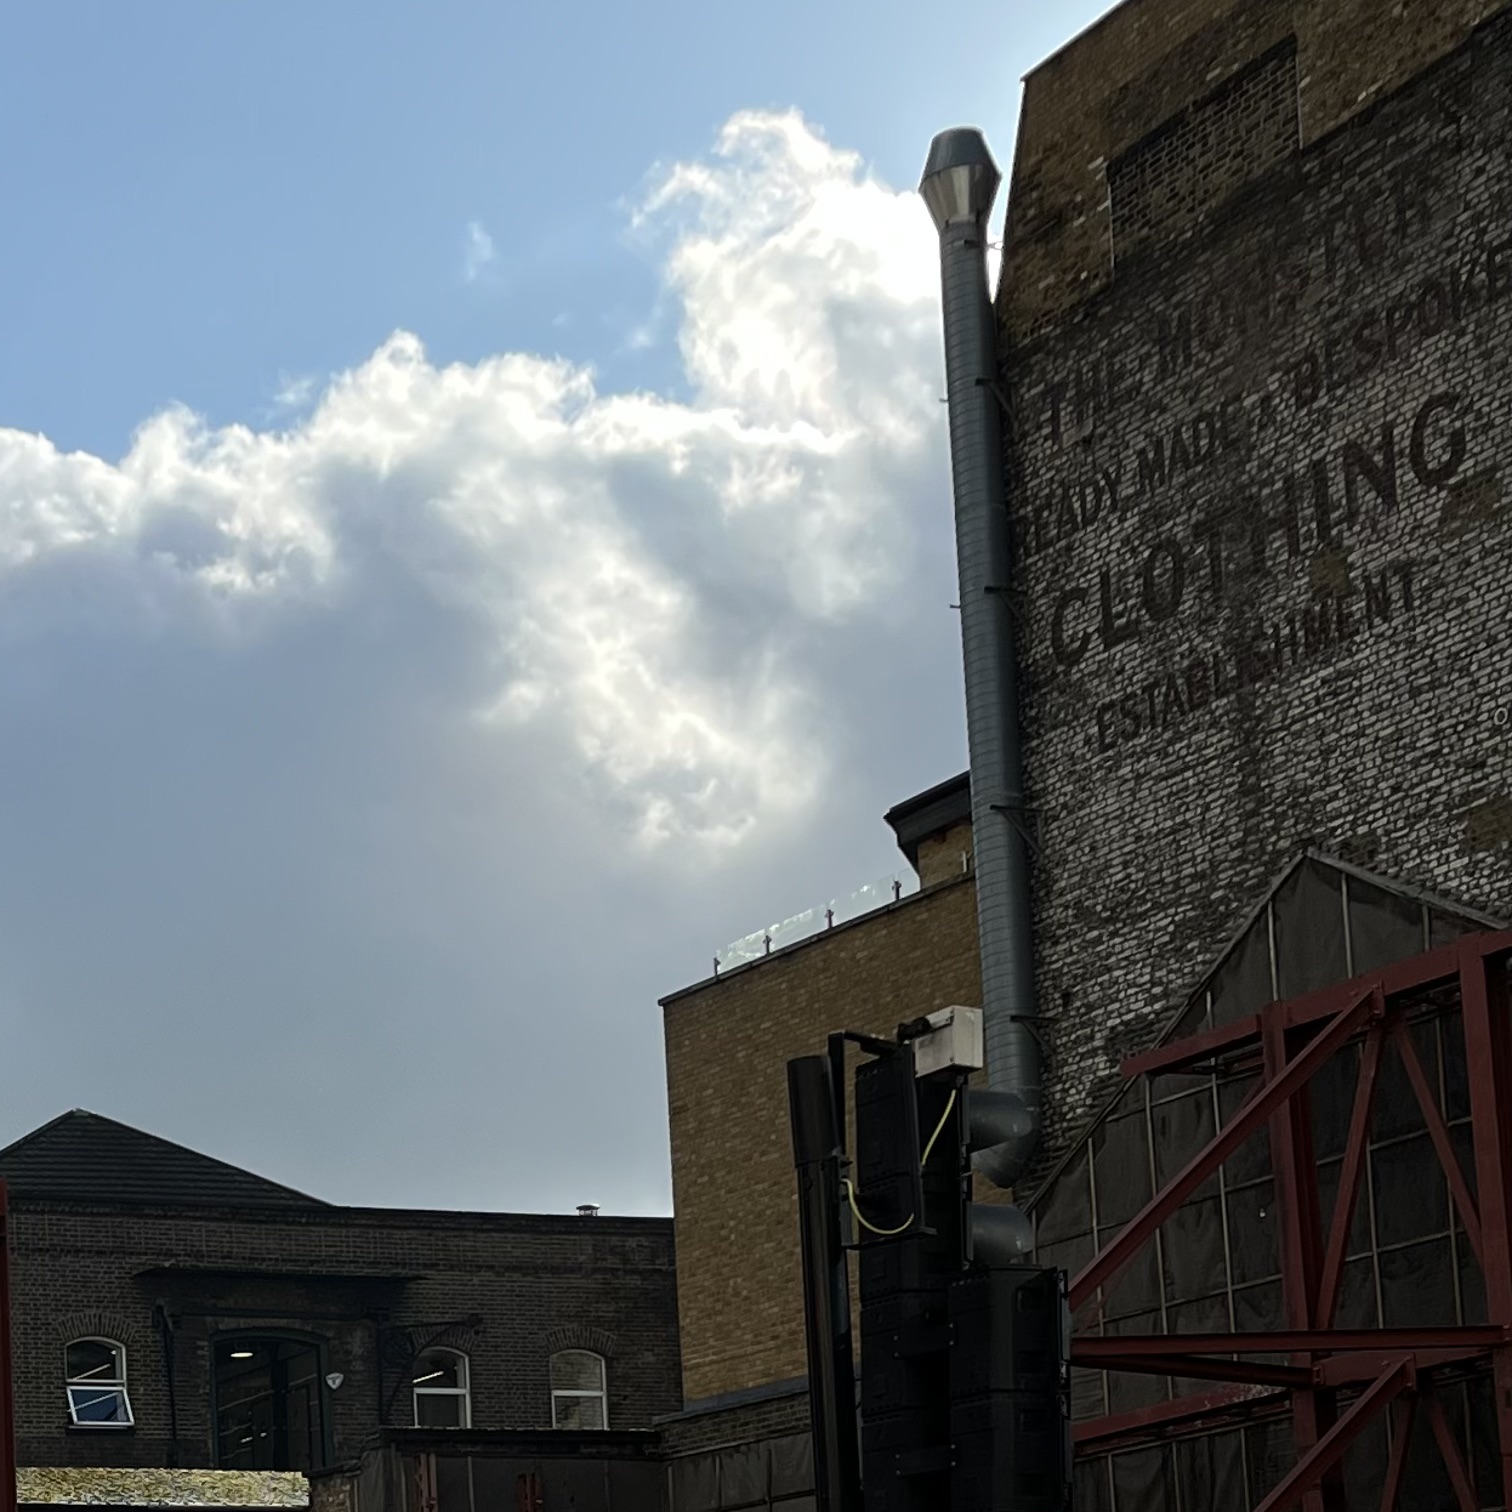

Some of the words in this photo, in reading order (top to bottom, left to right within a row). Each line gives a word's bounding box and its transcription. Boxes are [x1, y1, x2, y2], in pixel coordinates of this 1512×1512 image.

[1050, 386, 1467, 668] CLOTHING
[1137, 392, 1243, 496] MADE
[1094, 560, 1418, 755] ESTABLISHMENT
